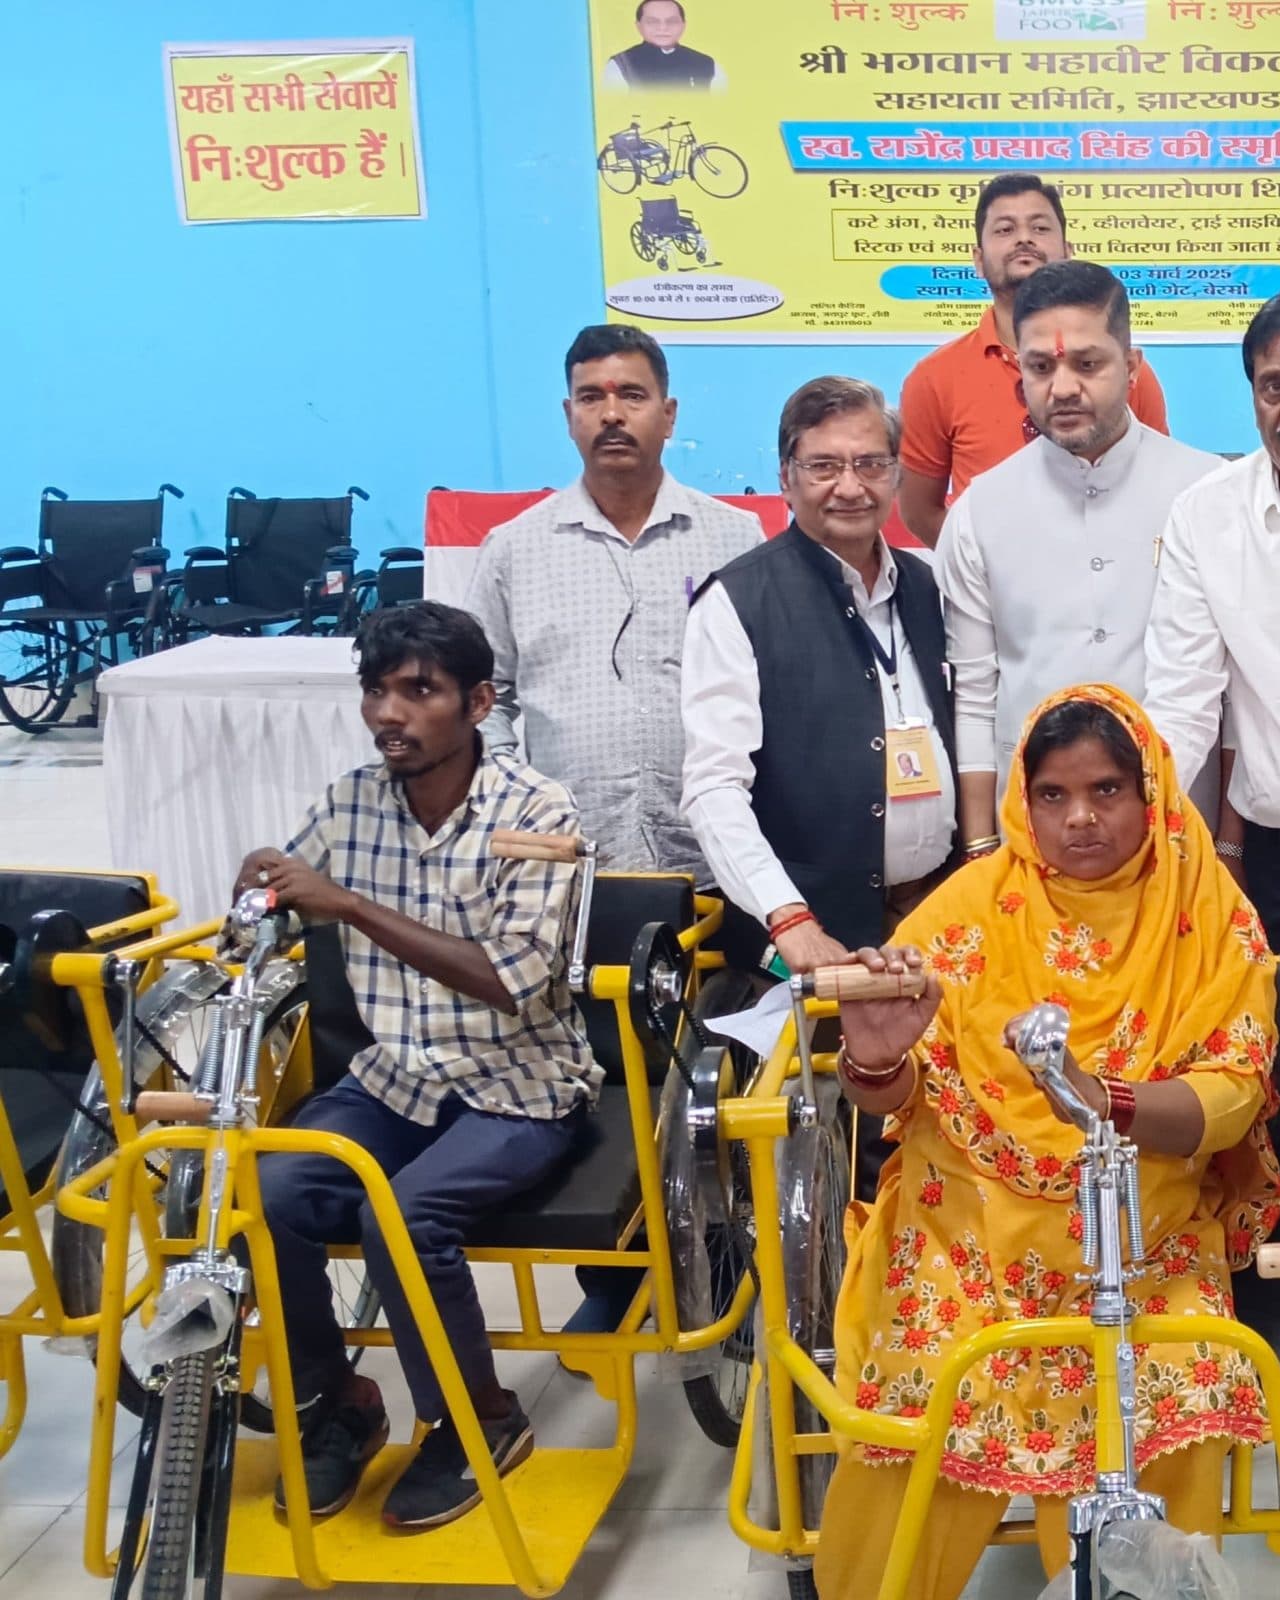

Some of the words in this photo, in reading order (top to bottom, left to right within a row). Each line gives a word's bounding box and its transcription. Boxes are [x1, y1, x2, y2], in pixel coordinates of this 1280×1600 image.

[889, 2, 969, 31] शुल्क
[799, 45, 848, 74] श्री
[861, 52, 1012, 74] भगवान
[1022, 44, 1170, 74] महावीर
[179, 73, 234, 113] यहाँ
[241, 73, 305, 112] सभी
[312, 69, 398, 111] सेवायें
[873, 92, 1001, 110] सहायता
[1009, 86, 1125, 113] समिति,
[355, 128, 388, 178] हैं
[799, 136, 861, 159] स्व.
[869, 130, 964, 160] राजेंद्र
[972, 136, 1070, 160] प्रसाद
[1080, 130, 1152, 160] सिंह
[1160, 130, 1210, 159] की
[1101, 178, 1242, 200] प्रत्यारोपण
[847, 215, 881, 230] कटे
[885, 216, 927, 231] अंग,
[1191, 213, 1222, 231] ट्राई
[854, 239, 902, 253] स्टिक
[908, 240, 934, 253] एवं
[1107, 239, 1170, 253] वितरण
[1176, 239, 1225, 253] किया
[1228, 241, 1271, 252] जाता
[1119, 270, 1141, 279] 03
[1147, 266, 1181, 279] मार्च
[1186, 269, 1232, 279] 2025
[1202, 282, 1250, 295] बेरमो
